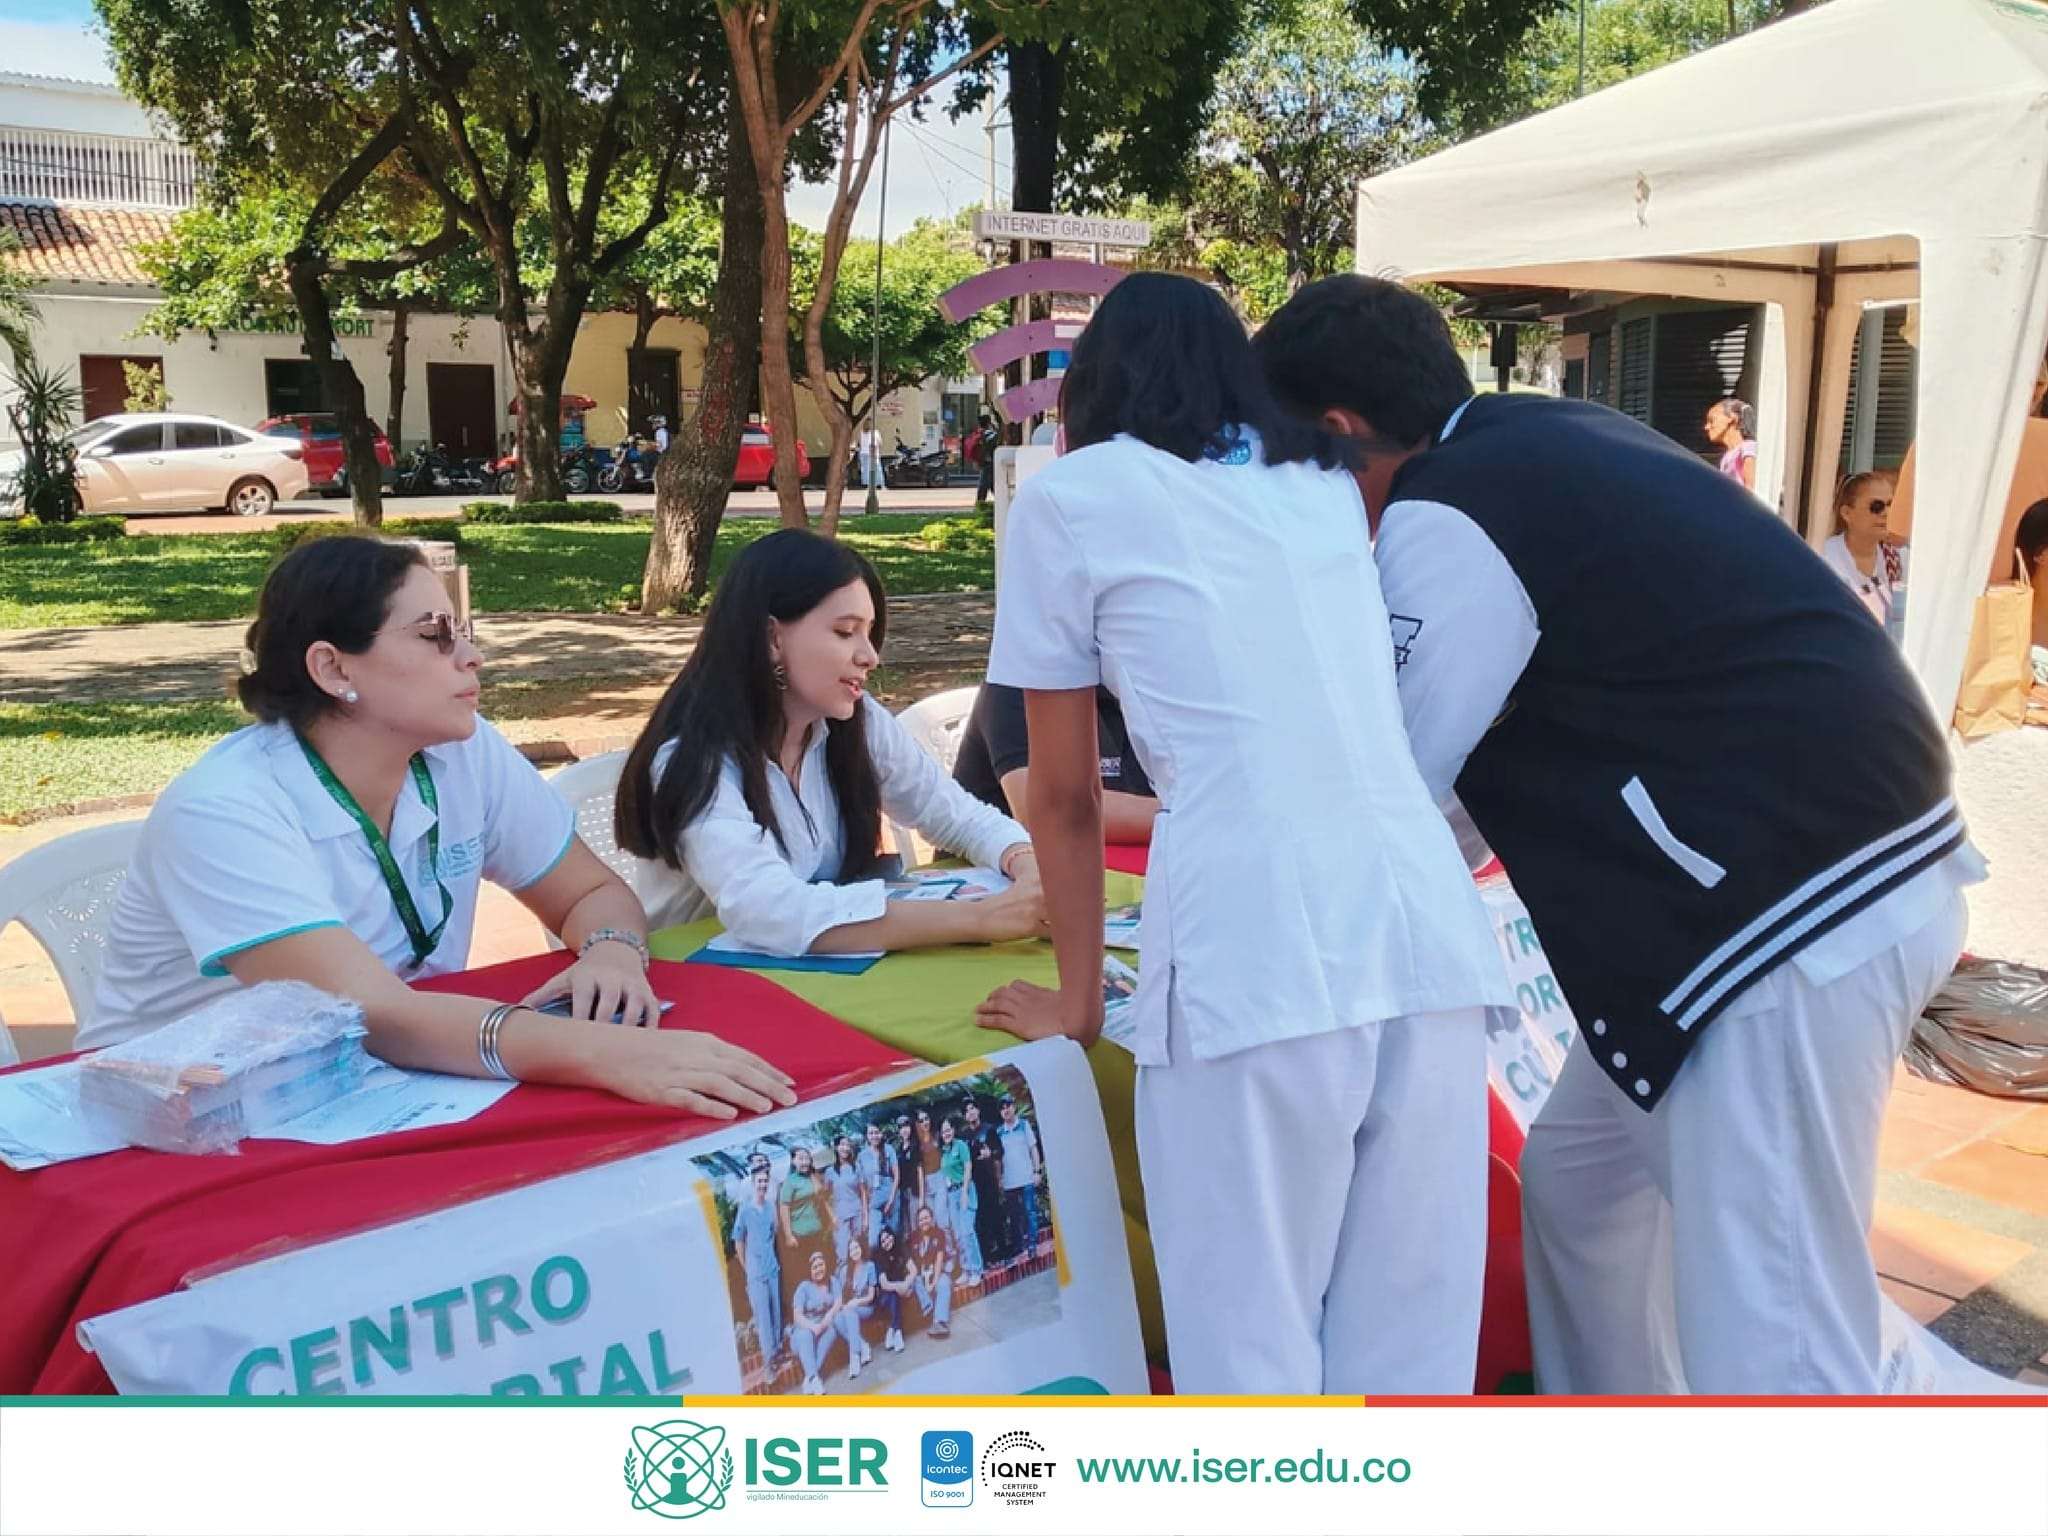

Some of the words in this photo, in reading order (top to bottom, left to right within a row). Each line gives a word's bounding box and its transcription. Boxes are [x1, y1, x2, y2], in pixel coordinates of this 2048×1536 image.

[988, 214, 1058, 234] INTERNET
[1061, 219, 1110, 240] GRATIS
[228, 1255, 591, 1395] CENTRO
